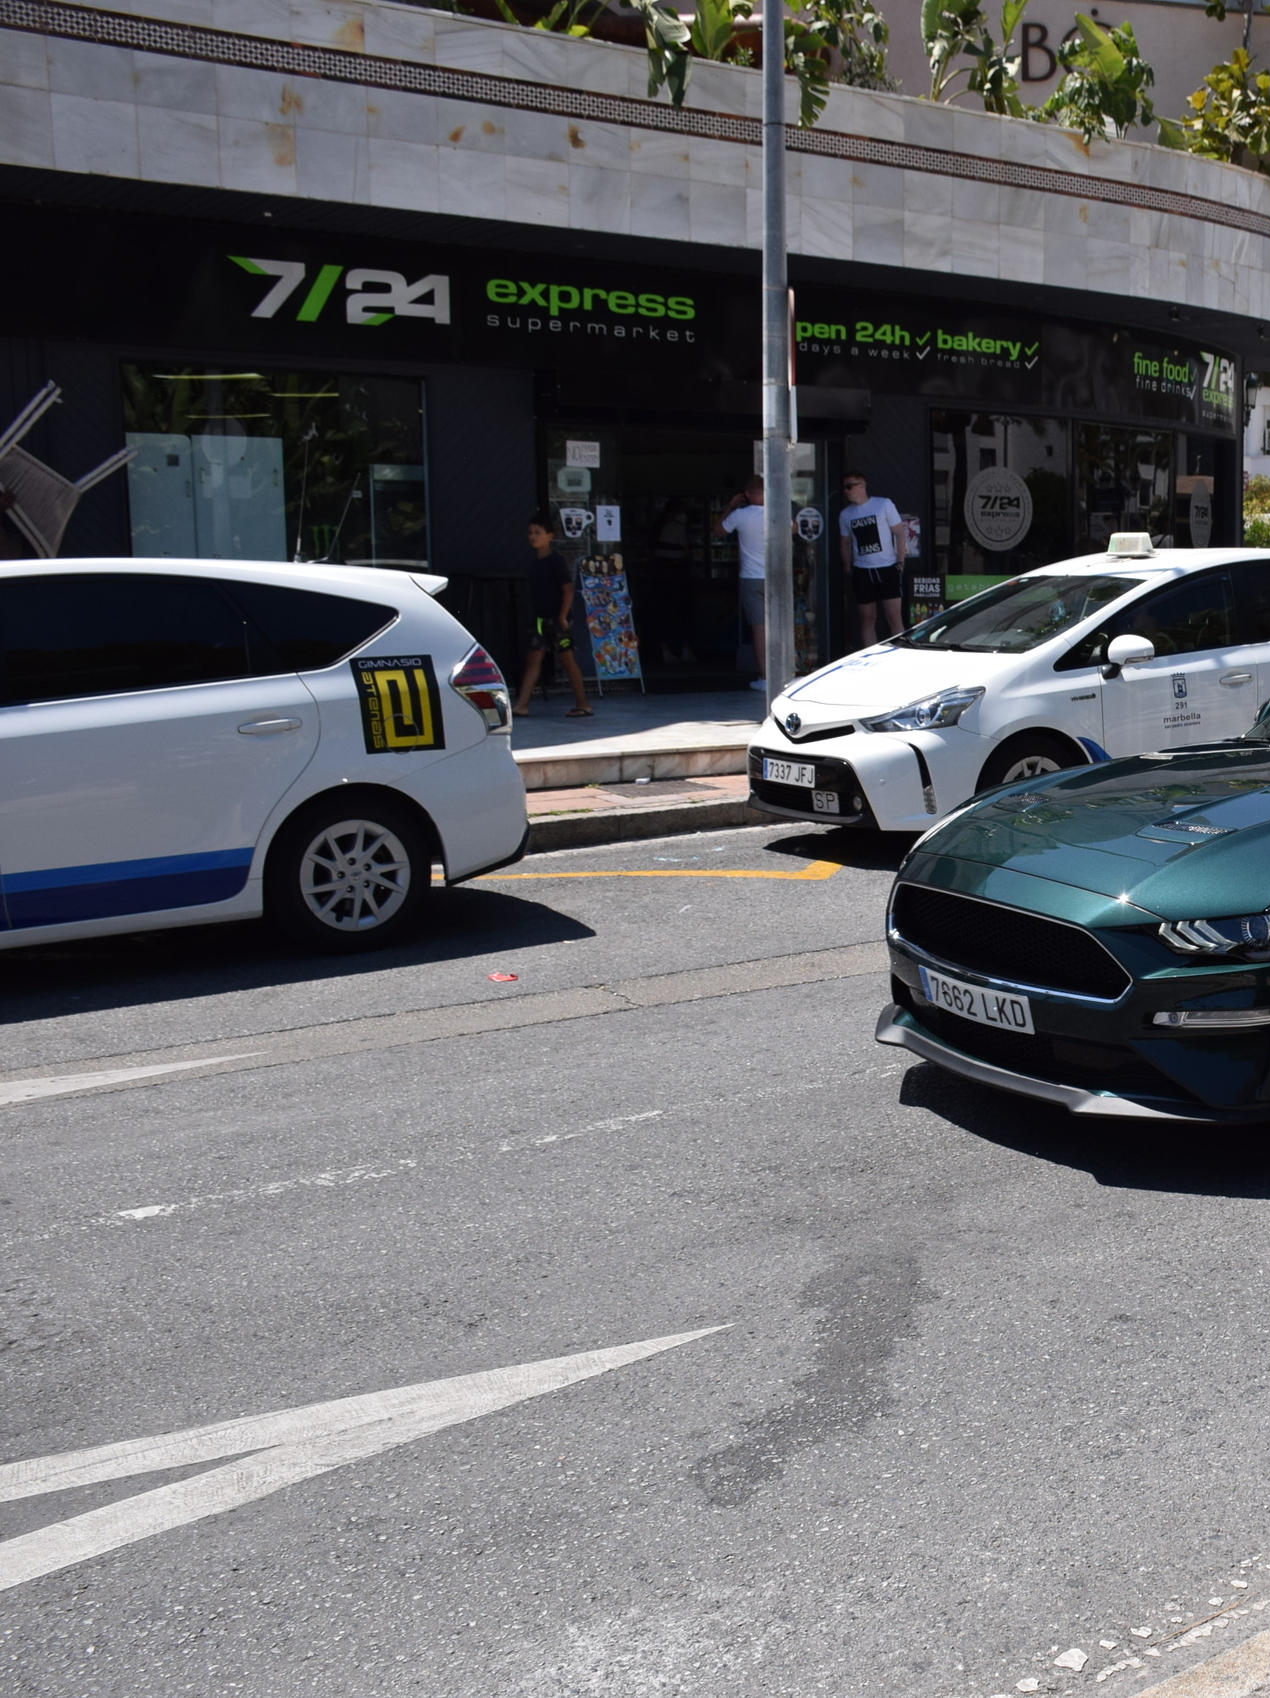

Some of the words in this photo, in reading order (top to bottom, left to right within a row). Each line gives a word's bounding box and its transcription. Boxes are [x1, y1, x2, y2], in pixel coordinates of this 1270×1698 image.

[227, 255, 450, 326] 7/24
[486, 278, 696, 320] express
[486, 313, 696, 343] supermarket
[795, 320, 847, 341] pen
[855, 321, 910, 346] 24h
[799, 341, 841, 354] days
[851, 346, 858, 355] a
[868, 350, 910, 360] week
[937, 329, 1021, 361] bakery
[937, 353, 974, 364] fresh
[981, 357, 1020, 369] bread
[1134, 352, 1159, 377] fine
[1162, 357, 1189, 383] food
[1136, 375, 1157, 391] fine
[1161, 381, 1190, 398] drinks
[978, 494, 1021, 510] 7/24
[851, 516, 876, 528] CALVIN
[981, 510, 1021, 519] express
[358, 658, 422, 669] GIMNASIO
[1175, 701, 1187, 710] 291
[1163, 713, 1201, 724] marbella
[769, 762, 792, 781] 7337
[795, 766, 814, 784] JFJ
[814, 792, 836, 810] SP
[930, 975, 978, 1017] 7662
[981, 993, 1026, 1028] LKD
